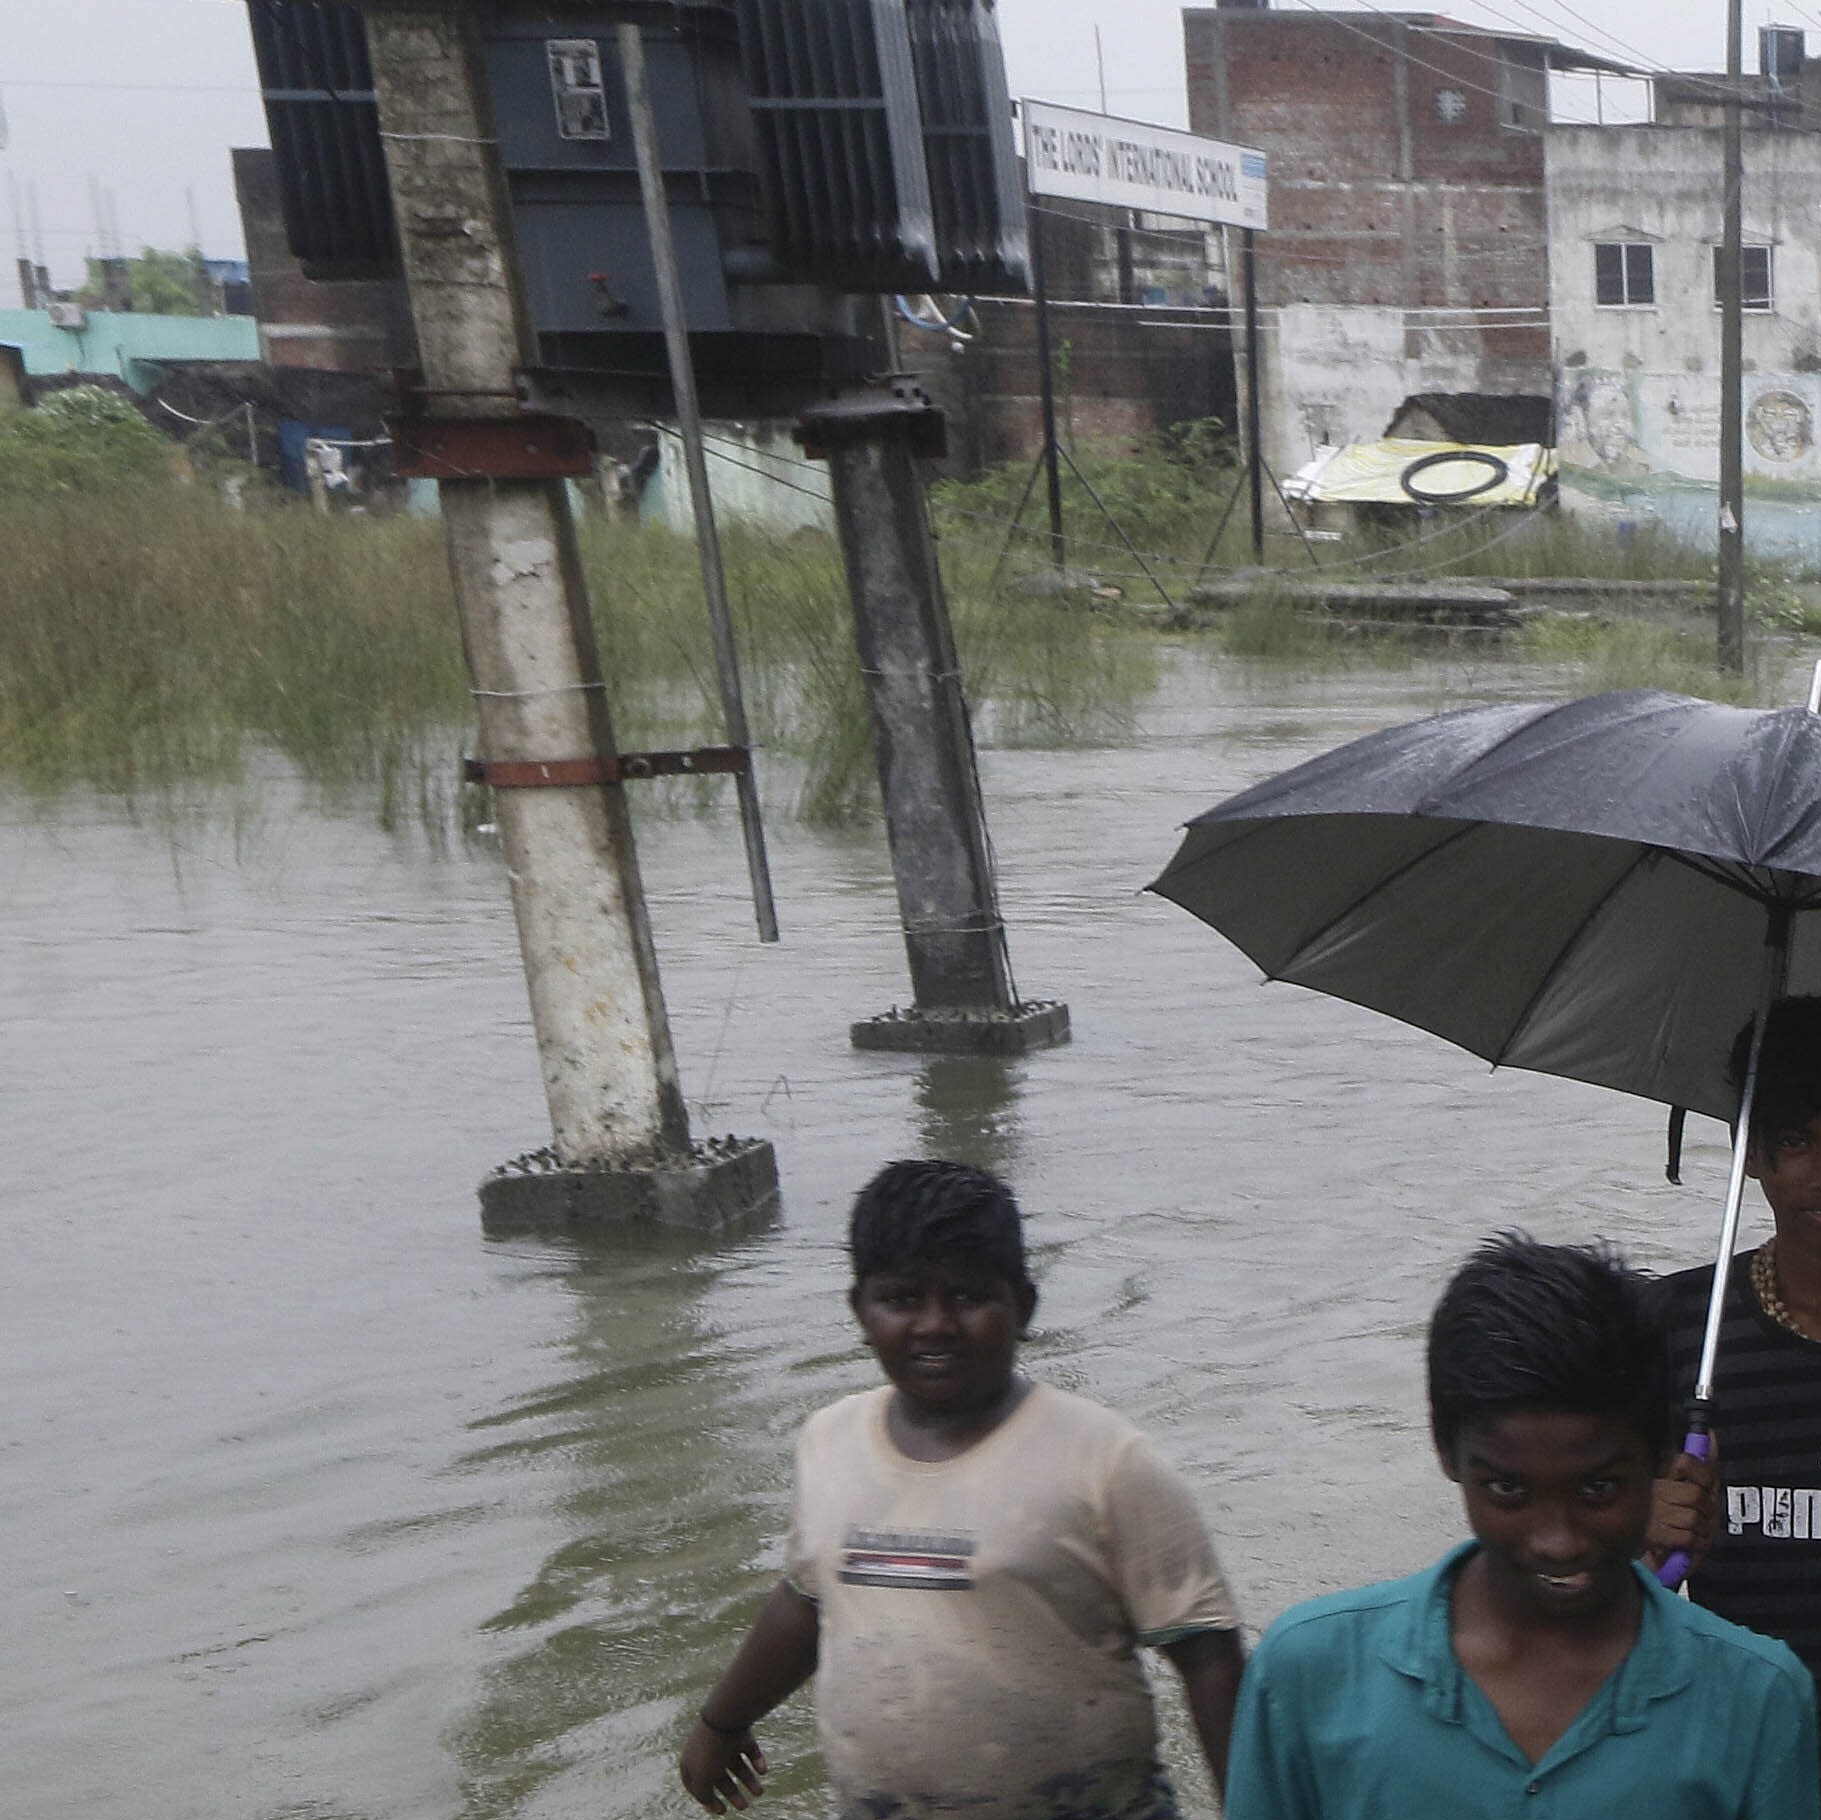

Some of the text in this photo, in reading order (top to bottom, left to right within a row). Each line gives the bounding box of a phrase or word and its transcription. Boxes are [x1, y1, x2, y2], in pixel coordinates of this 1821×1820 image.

[1032, 125, 1058, 171] THE
[1104, 139, 1193, 192] INTERNATIONAL
[1195, 155, 1238, 202] SCHOOL
